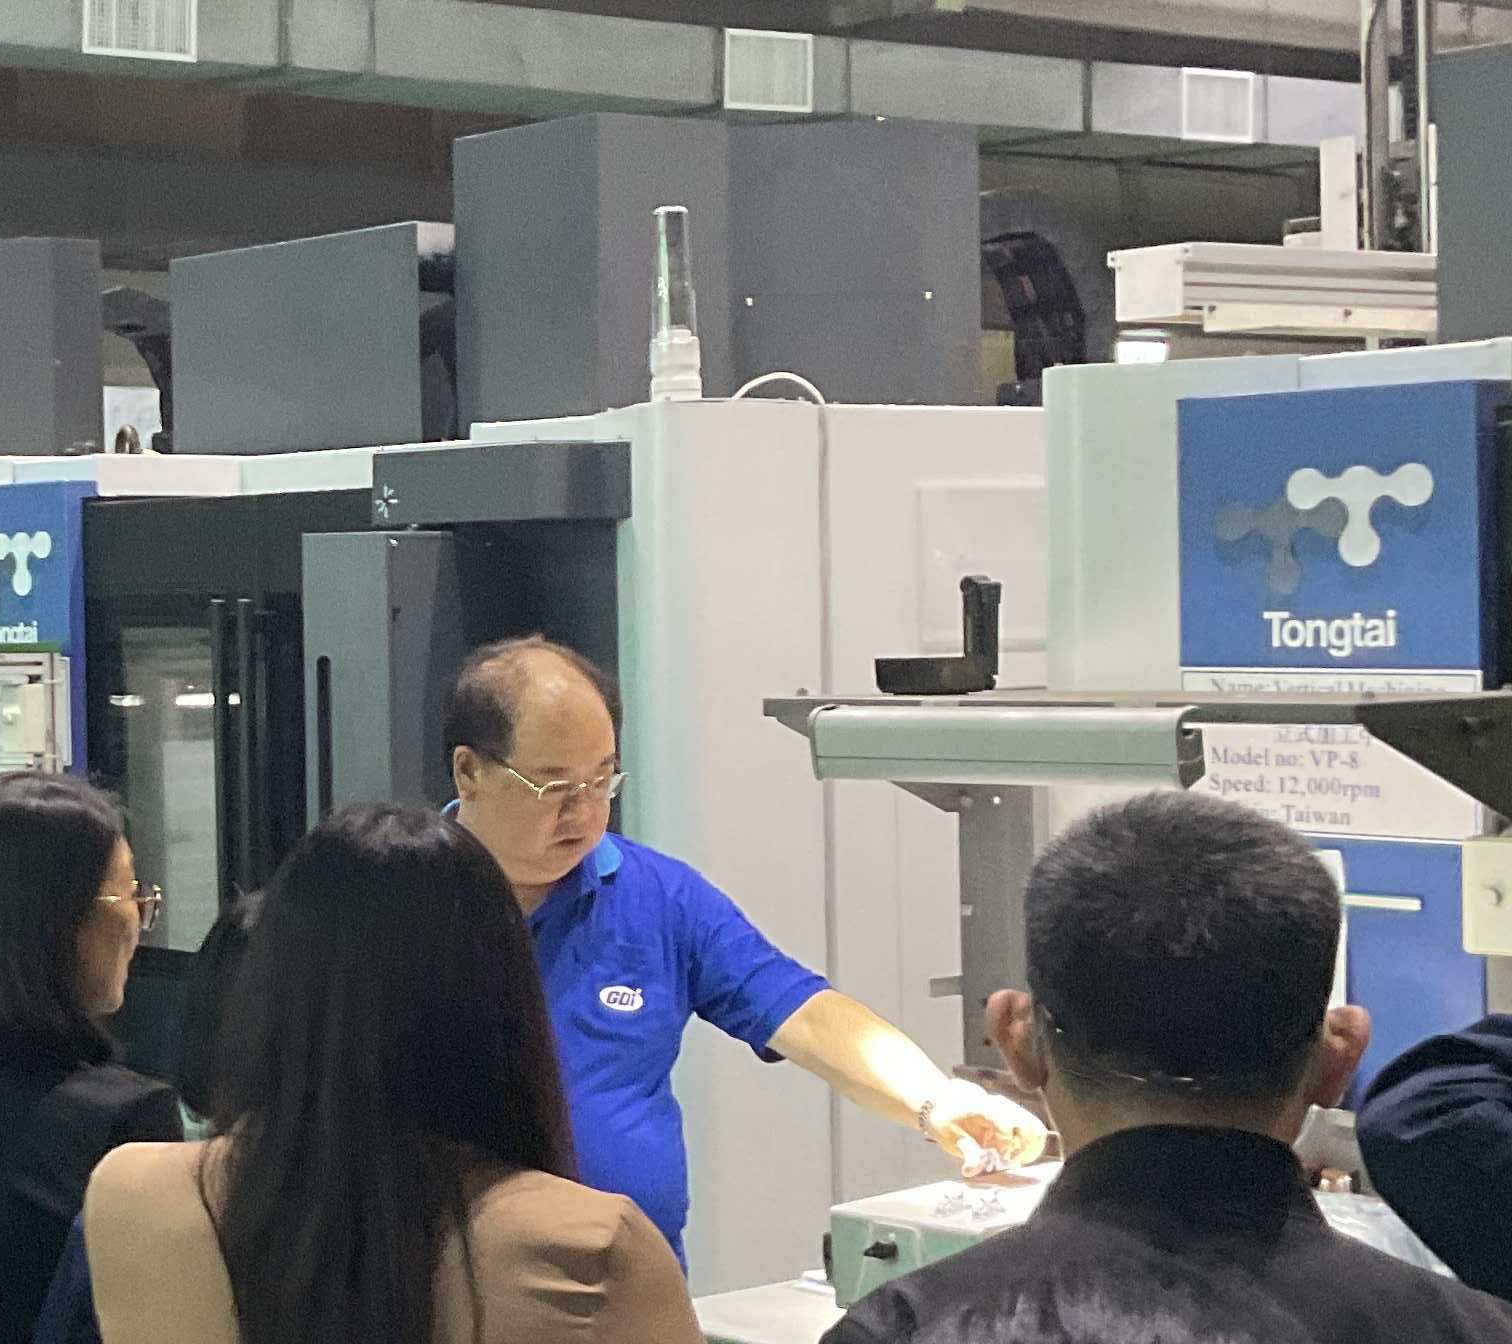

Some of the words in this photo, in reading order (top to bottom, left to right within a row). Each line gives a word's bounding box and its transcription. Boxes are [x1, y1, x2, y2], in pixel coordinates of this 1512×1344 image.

[1262, 609, 1396, 657] Tongtai
[1210, 746, 1270, 766] Model
[1275, 754, 1304, 767] no:
[1310, 750, 1360, 769] VP-8
[1209, 773, 1272, 795] Speed:
[1279, 775, 1380, 802] 12,000rpm
[1281, 804, 1351, 825] Taiwan
